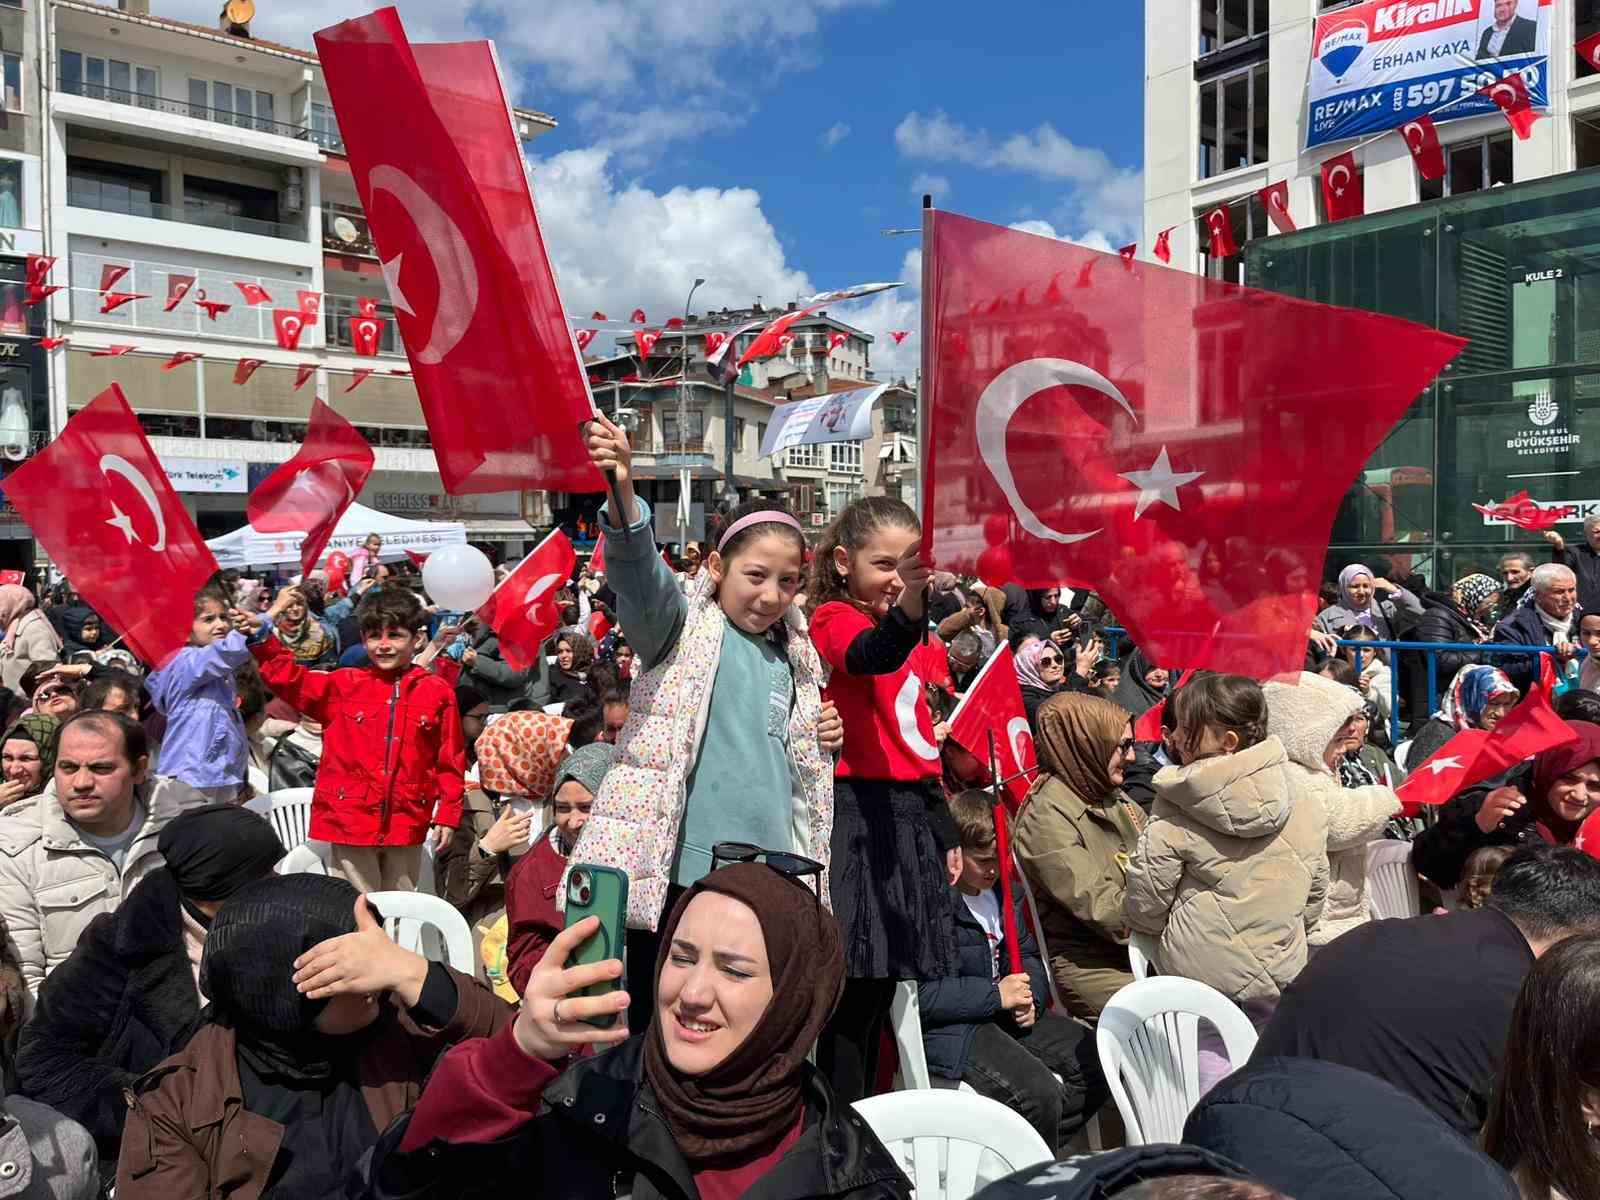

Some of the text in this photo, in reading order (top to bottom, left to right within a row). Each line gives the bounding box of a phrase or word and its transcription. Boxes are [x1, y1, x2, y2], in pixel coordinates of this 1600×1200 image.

[1324, 32, 1361, 49] RE/MAX
[1372, 39, 1471, 71] ERHAN KAYA
[1407, 78, 1456, 108] 597
[1314, 92, 1382, 122] RE/MAX
[1525, 269, 1563, 282] KULE 2
[186, 470, 224, 481] Telekom
